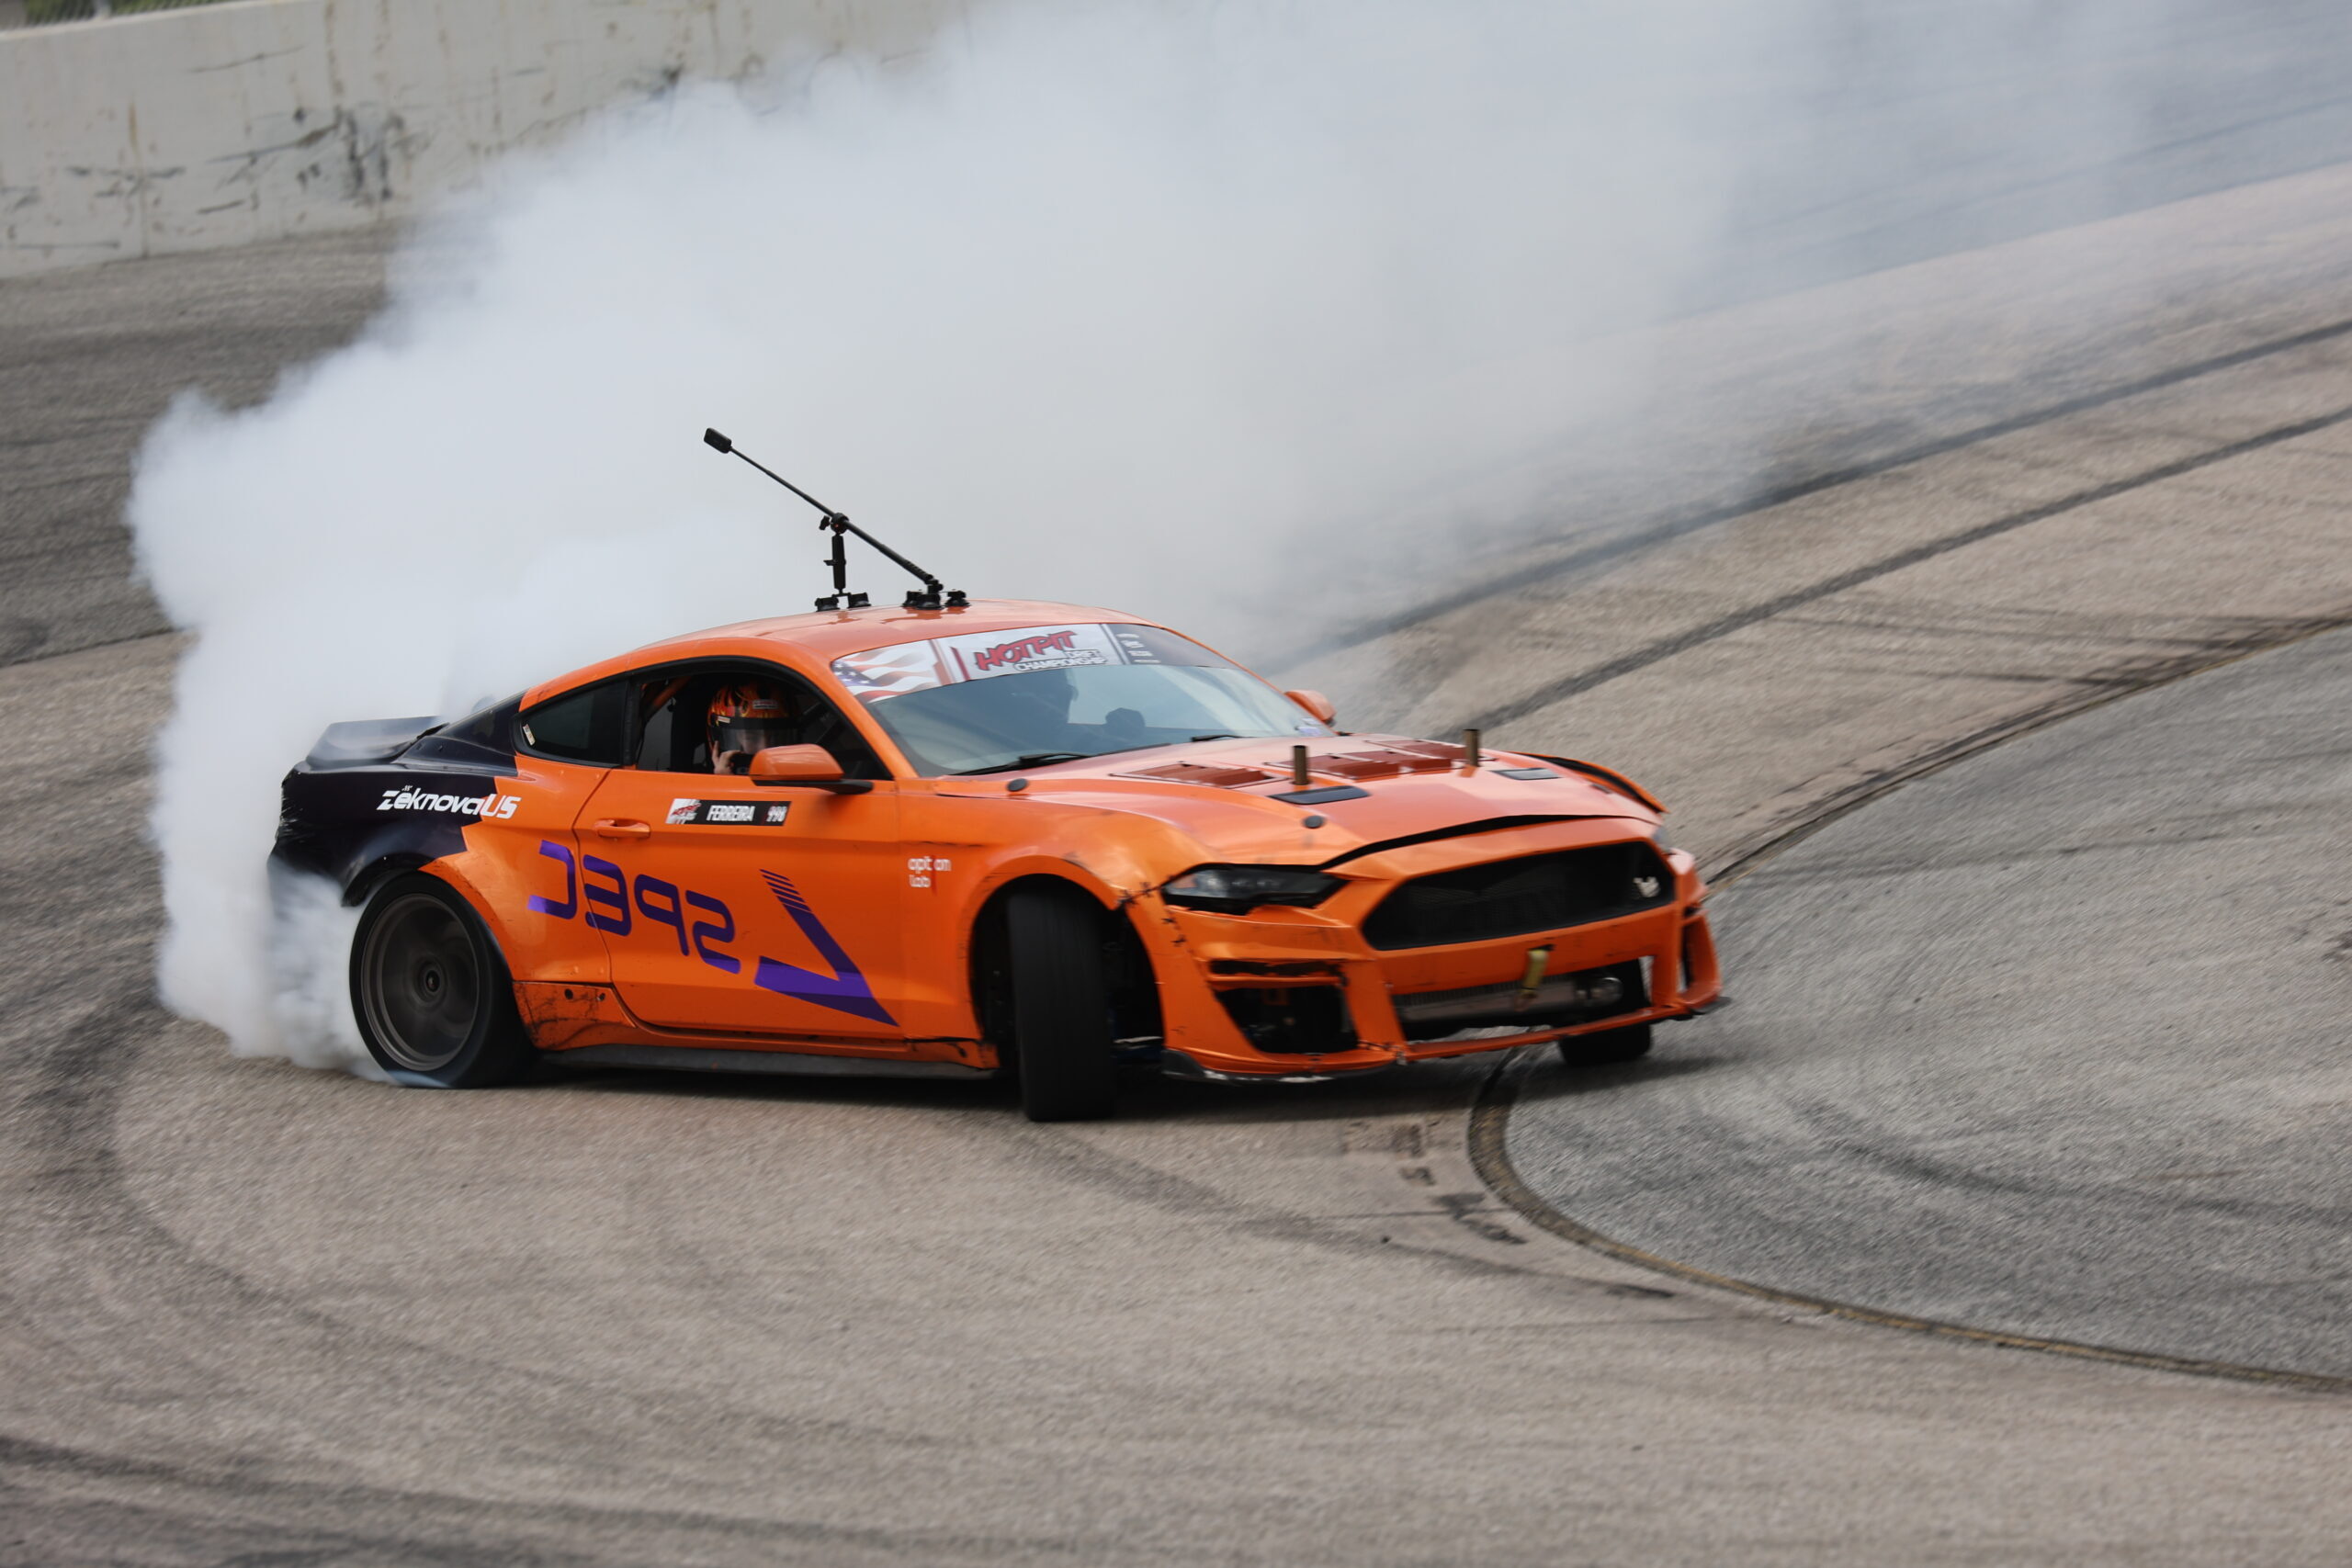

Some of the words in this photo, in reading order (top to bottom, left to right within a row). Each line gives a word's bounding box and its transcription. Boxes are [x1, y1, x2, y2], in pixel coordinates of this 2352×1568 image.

[973, 630, 1078, 671] HOTPIT
[1014, 657, 1107, 671] CHAMPIONSHIP
[706, 805, 756, 822] FERREIRA
